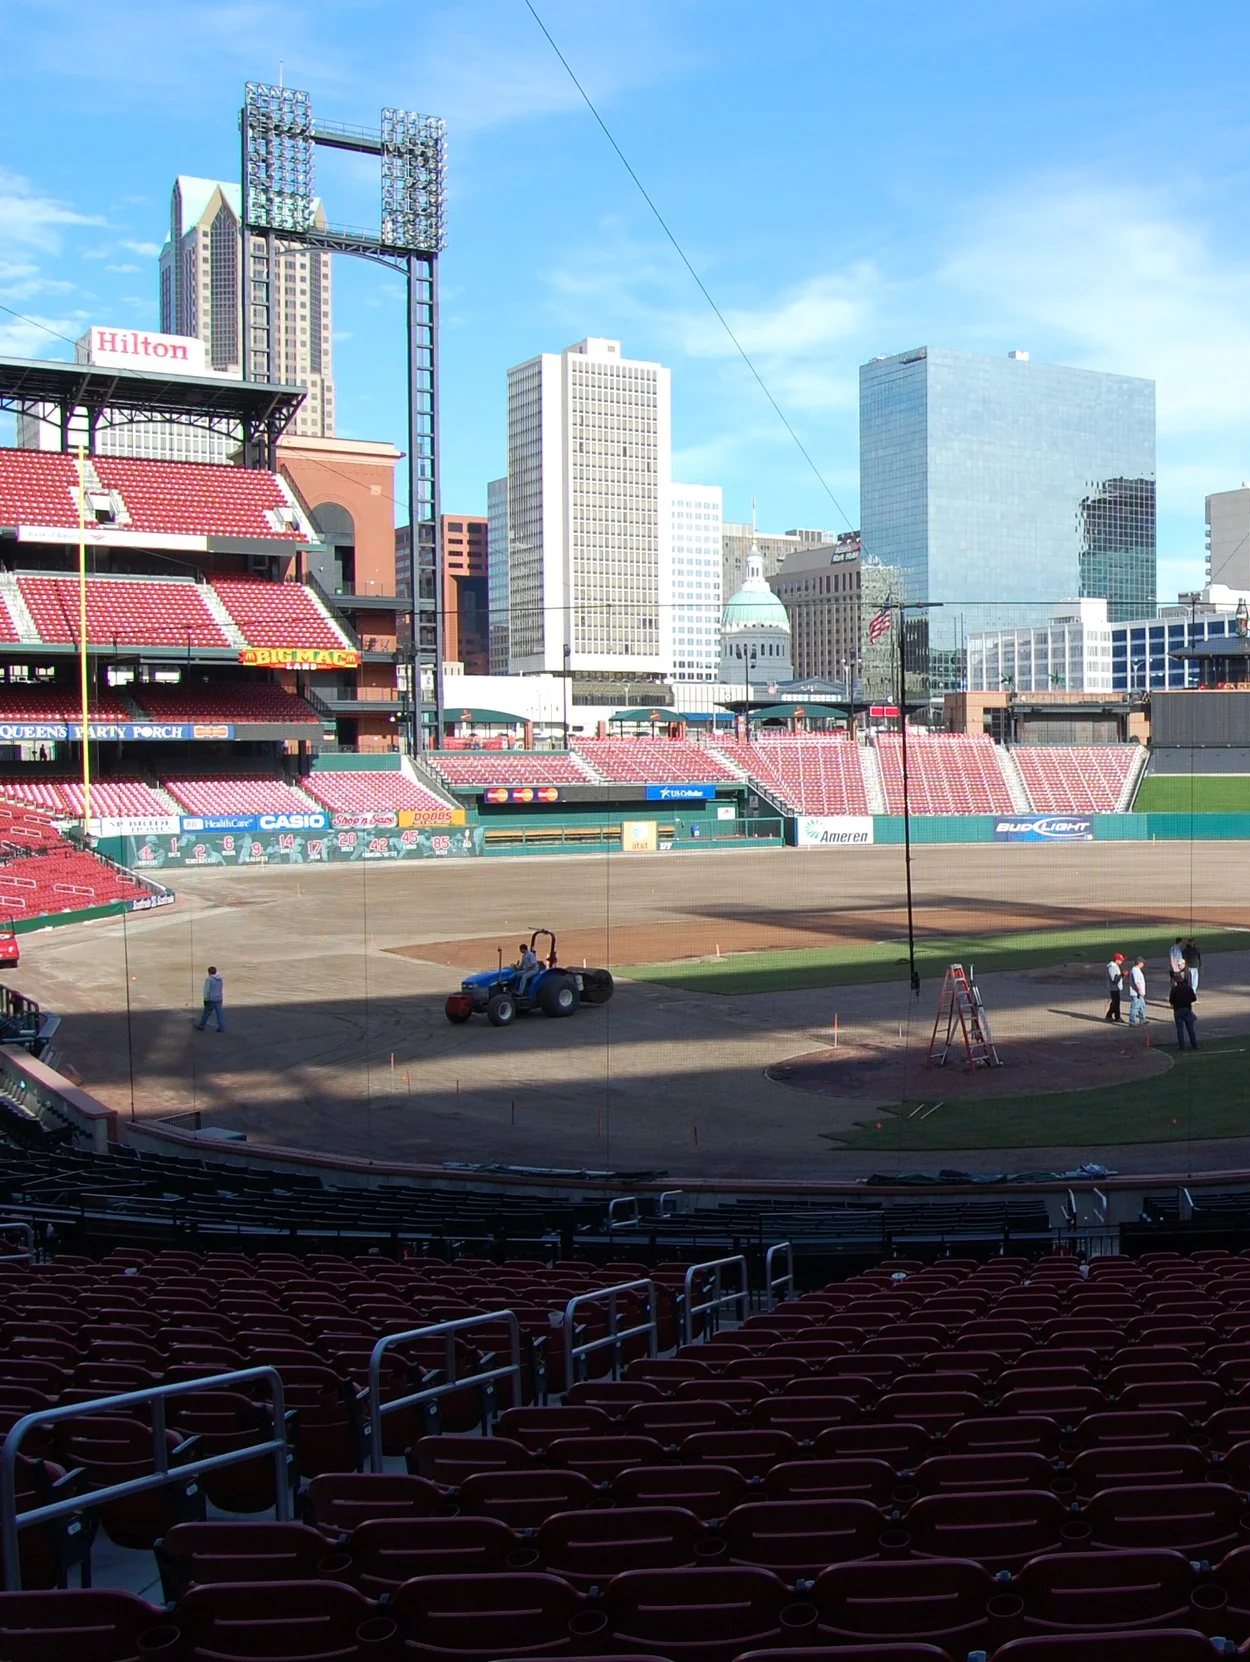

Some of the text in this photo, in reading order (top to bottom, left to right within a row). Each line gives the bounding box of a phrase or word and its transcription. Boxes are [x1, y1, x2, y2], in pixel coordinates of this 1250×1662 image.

[97, 331, 189, 361] Hilton
[256, 650, 347, 666] BIG MAC
[133, 726, 183, 739] PORCH
[205, 818, 251, 829] HealthCare
[260, 815, 325, 829] CASIO
[414, 812, 452, 821] DOBBS
[996, 822, 1090, 832] BUD LIGHT
[223, 836, 234, 850] 6
[279, 834, 294, 848] 14
[338, 832, 356, 846] 20
[401, 830, 418, 843] 45
[433, 836, 449, 850] 85
[820, 830, 868, 843] Ameren
[171, 837, 177, 852] 1
[195, 844, 205, 858] 2
[252, 842, 262, 856] 9
[307, 840, 321, 854] 17
[370, 838, 388, 852] 42
